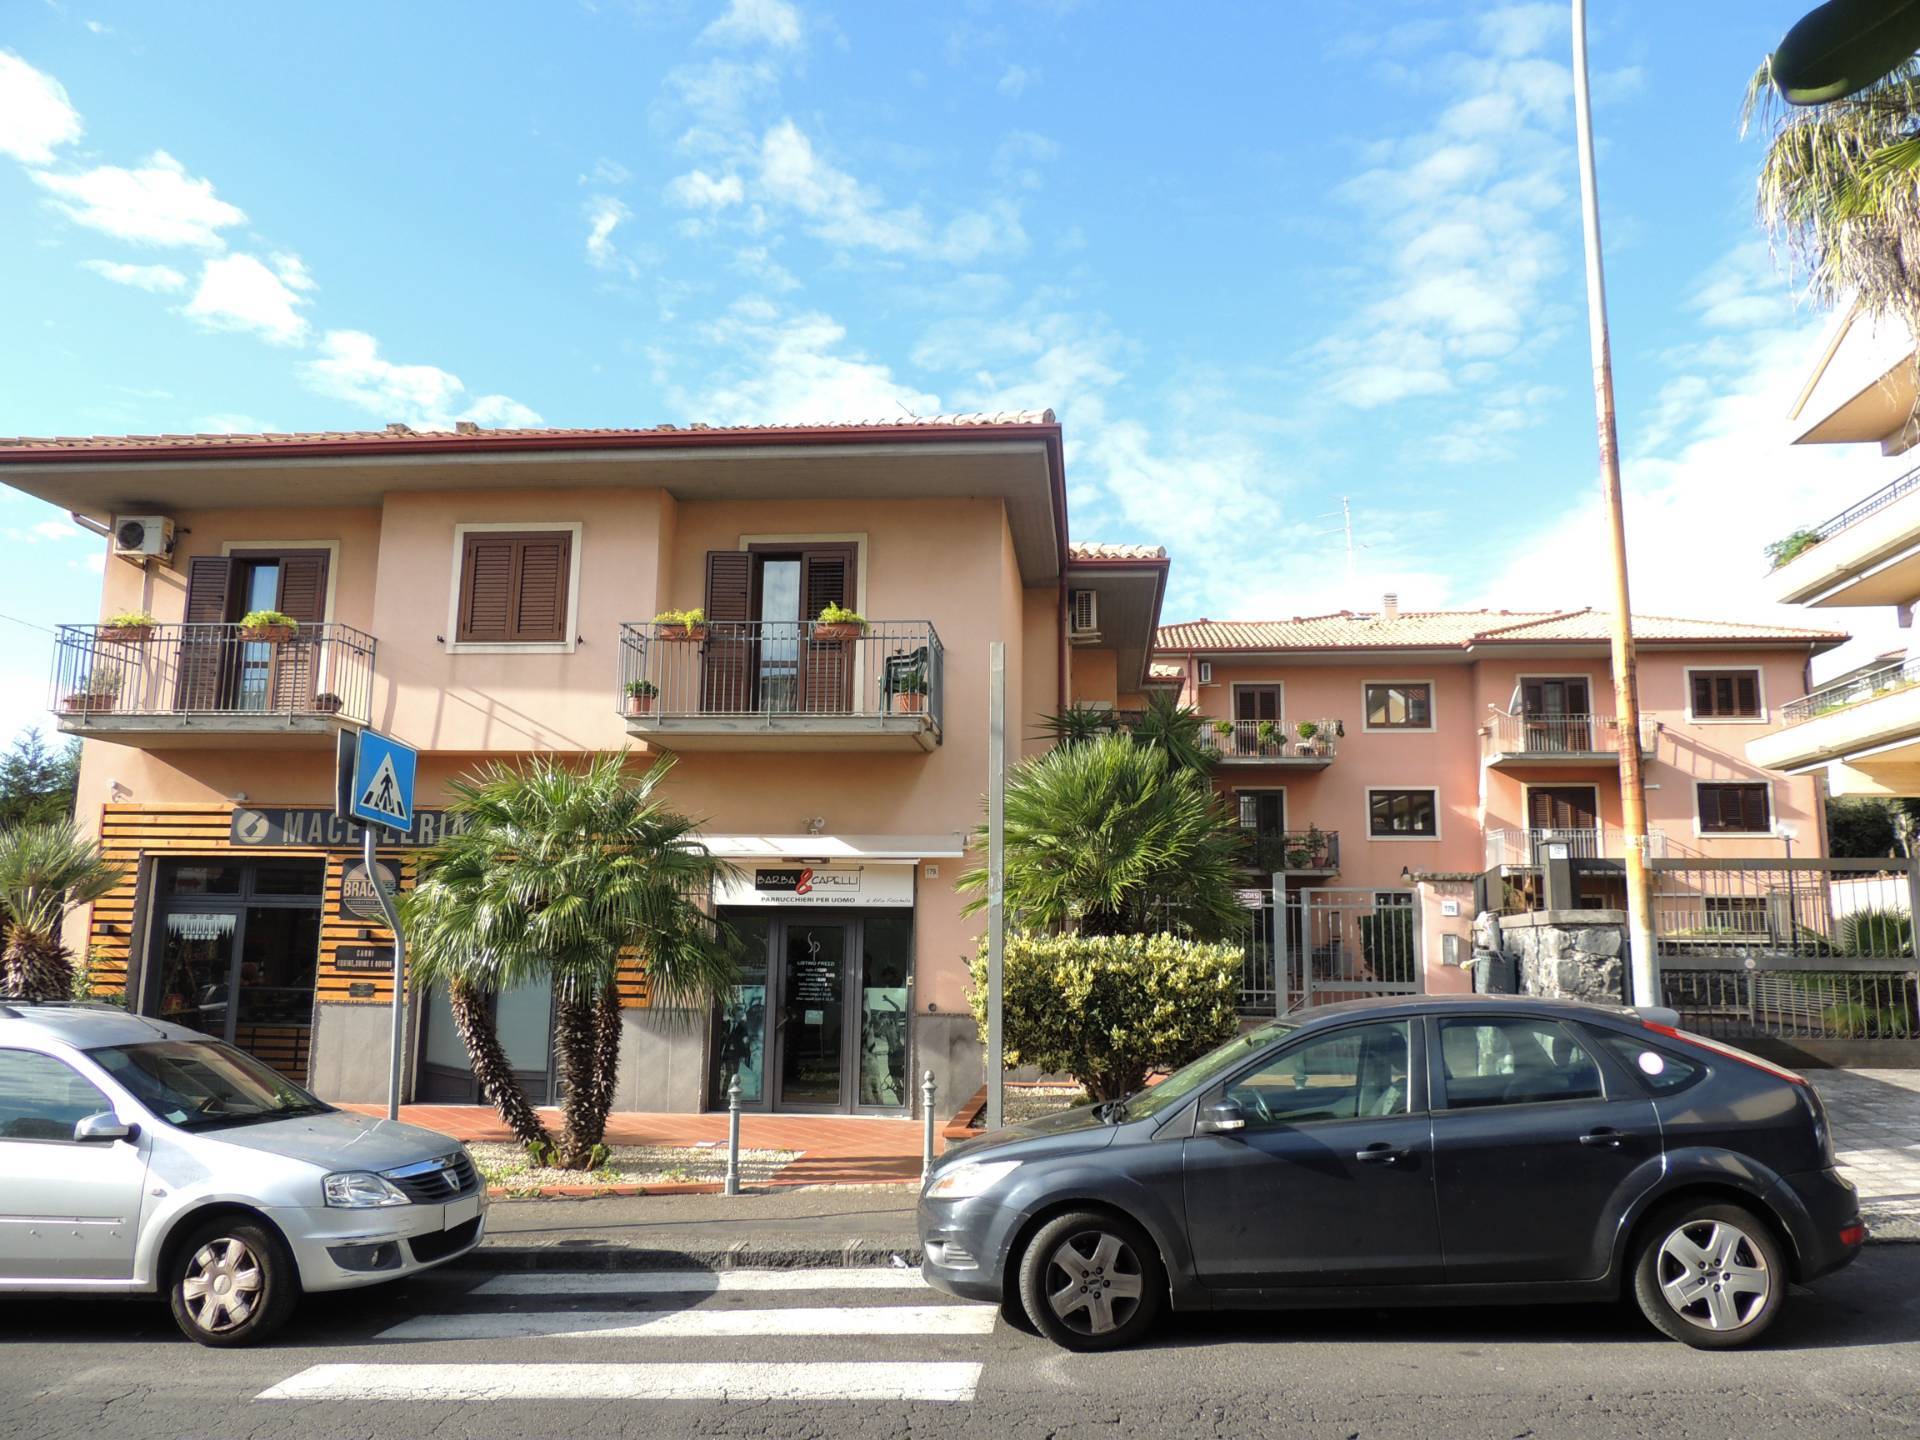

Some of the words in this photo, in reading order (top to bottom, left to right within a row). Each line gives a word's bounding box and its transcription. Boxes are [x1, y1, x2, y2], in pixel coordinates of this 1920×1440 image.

[282, 811, 466, 844] MACELERIA
[756, 875, 796, 885] BARBA
[795, 867, 813, 895] &
[812, 875, 858, 886] CAPELLI
